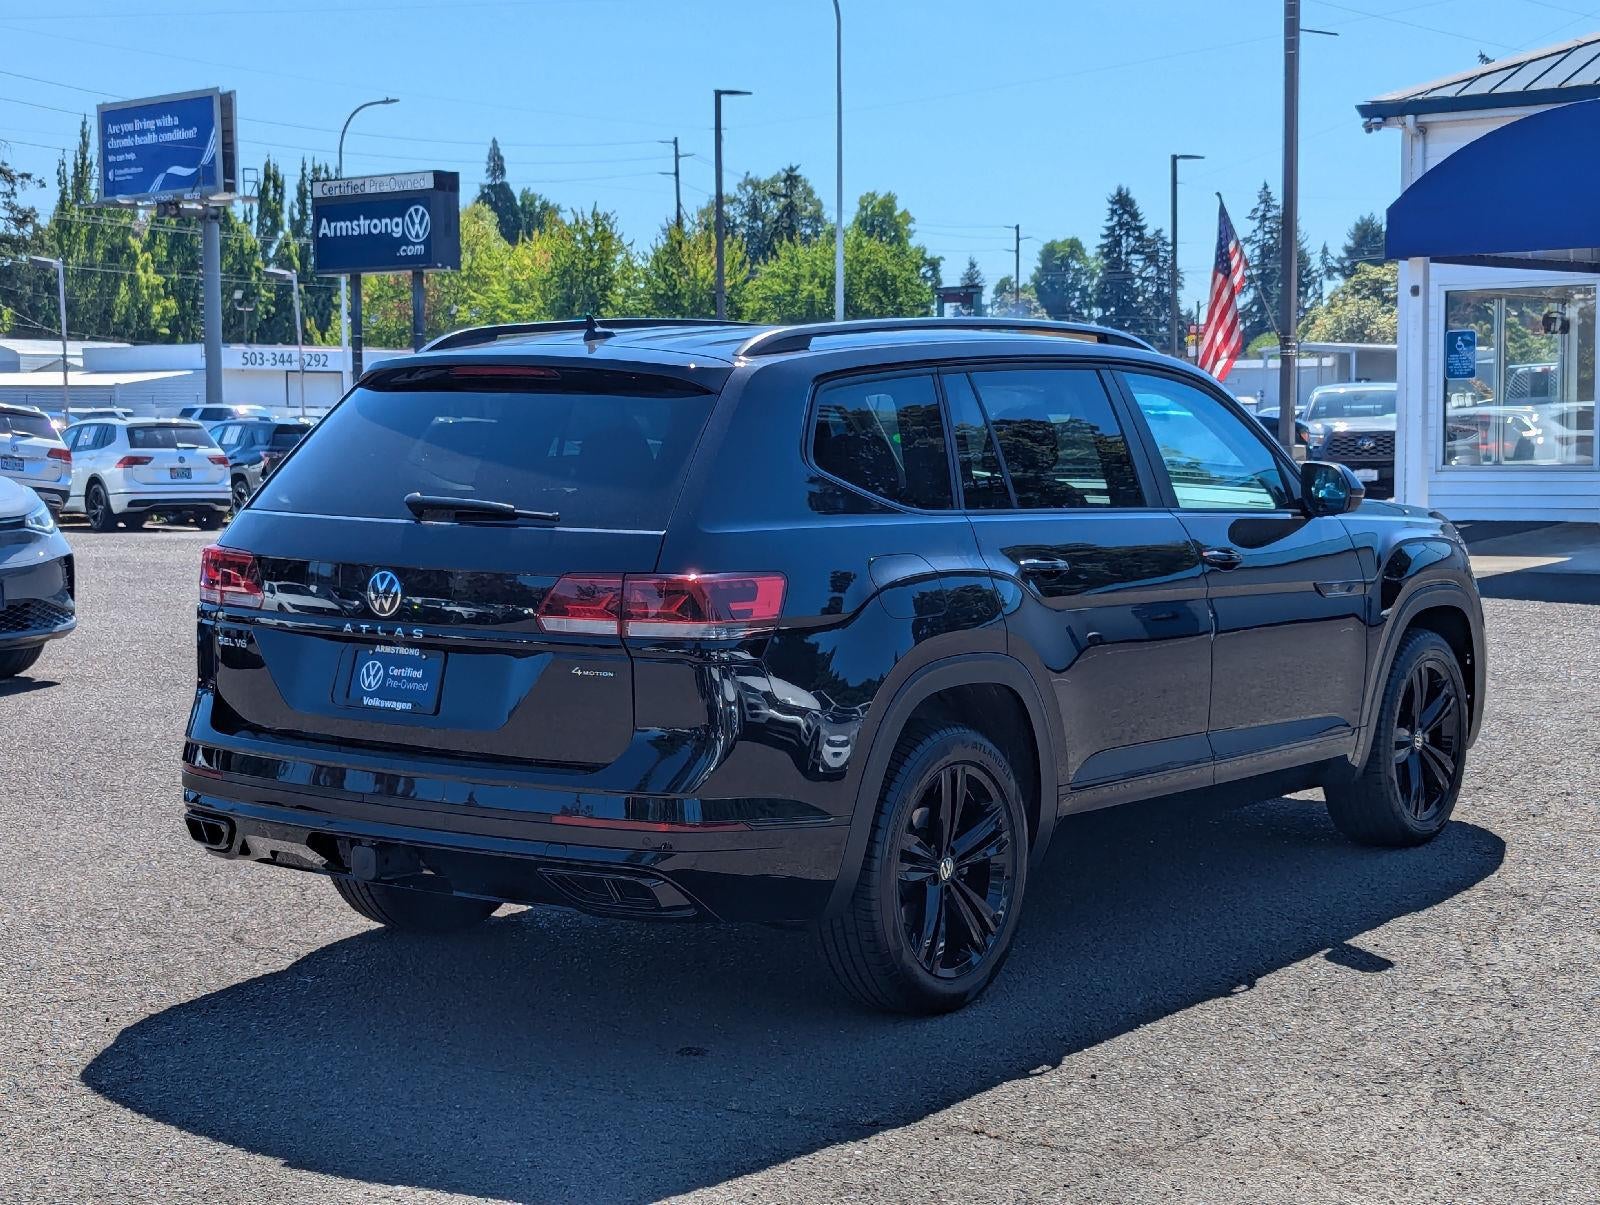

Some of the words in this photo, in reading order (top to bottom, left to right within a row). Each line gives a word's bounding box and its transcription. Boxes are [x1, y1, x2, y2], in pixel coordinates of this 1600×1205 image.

[107, 123, 120, 135] Are
[120, 121, 134, 135] you
[134, 118, 155, 131] living
[156, 114, 173, 127] with
[173, 117, 179, 125] a
[107, 135, 134, 149] chronic
[135, 132, 158, 145] health
[159, 127, 198, 142] condition?
[321, 181, 365, 196] Certified
[369, 177, 425, 192] Pre-Owned
[318, 214, 403, 238] Armstrong
[397, 244, 424, 257] .com
[342, 623, 424, 639] ATLAS
[218, 636, 235, 647] SEL
[235, 638, 247, 648] V6
[375, 644, 421, 656] ARMSTRONG
[388, 666, 423, 678] Certified
[571, 666, 614, 677] 4MOTION
[385, 678, 429, 692] Pre-Owned
[363, 696, 412, 711] Volkswagen
